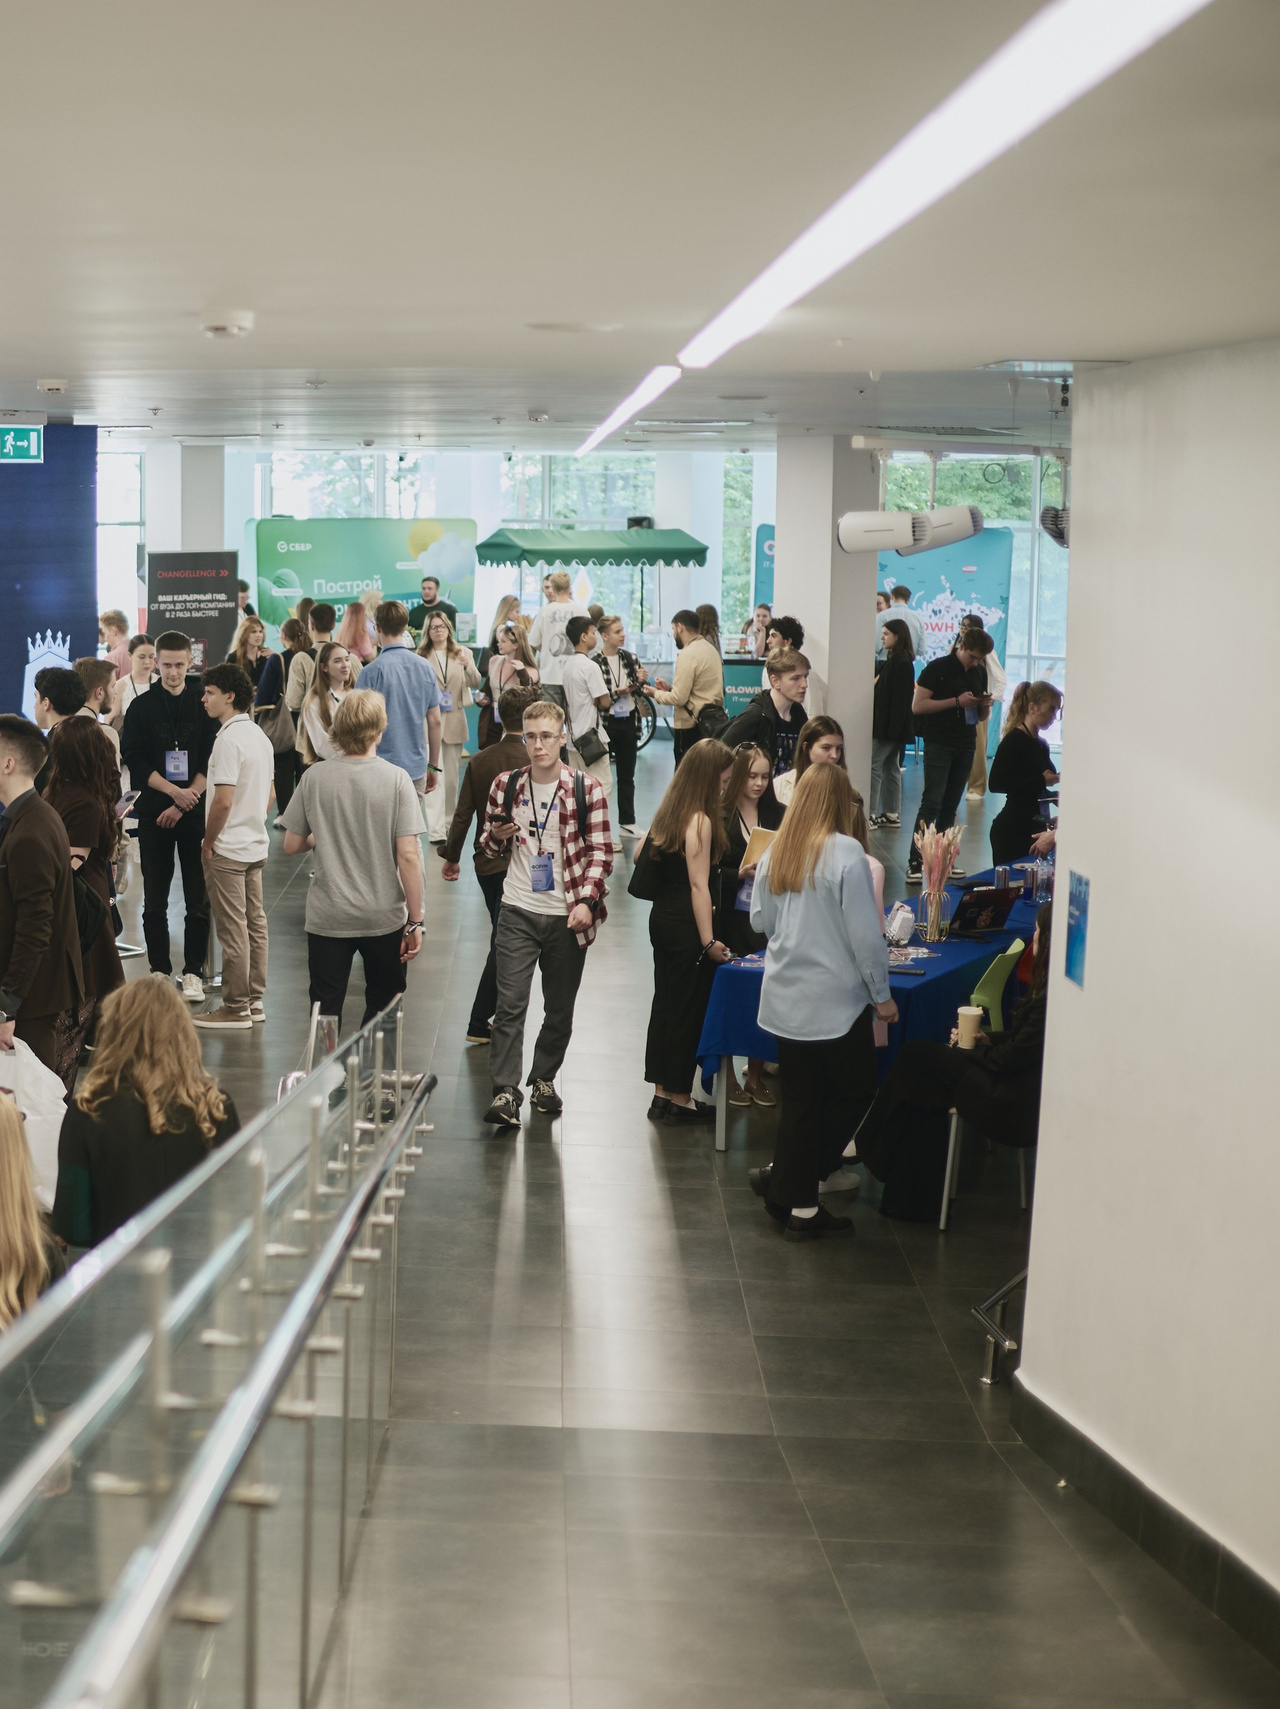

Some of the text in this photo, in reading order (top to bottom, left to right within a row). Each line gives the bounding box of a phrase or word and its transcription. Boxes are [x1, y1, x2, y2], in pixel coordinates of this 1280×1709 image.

[289, 543, 312, 551] СБЕР
[157, 570, 216, 578] CHANGELLENGE
[313, 575, 383, 595] Построй
